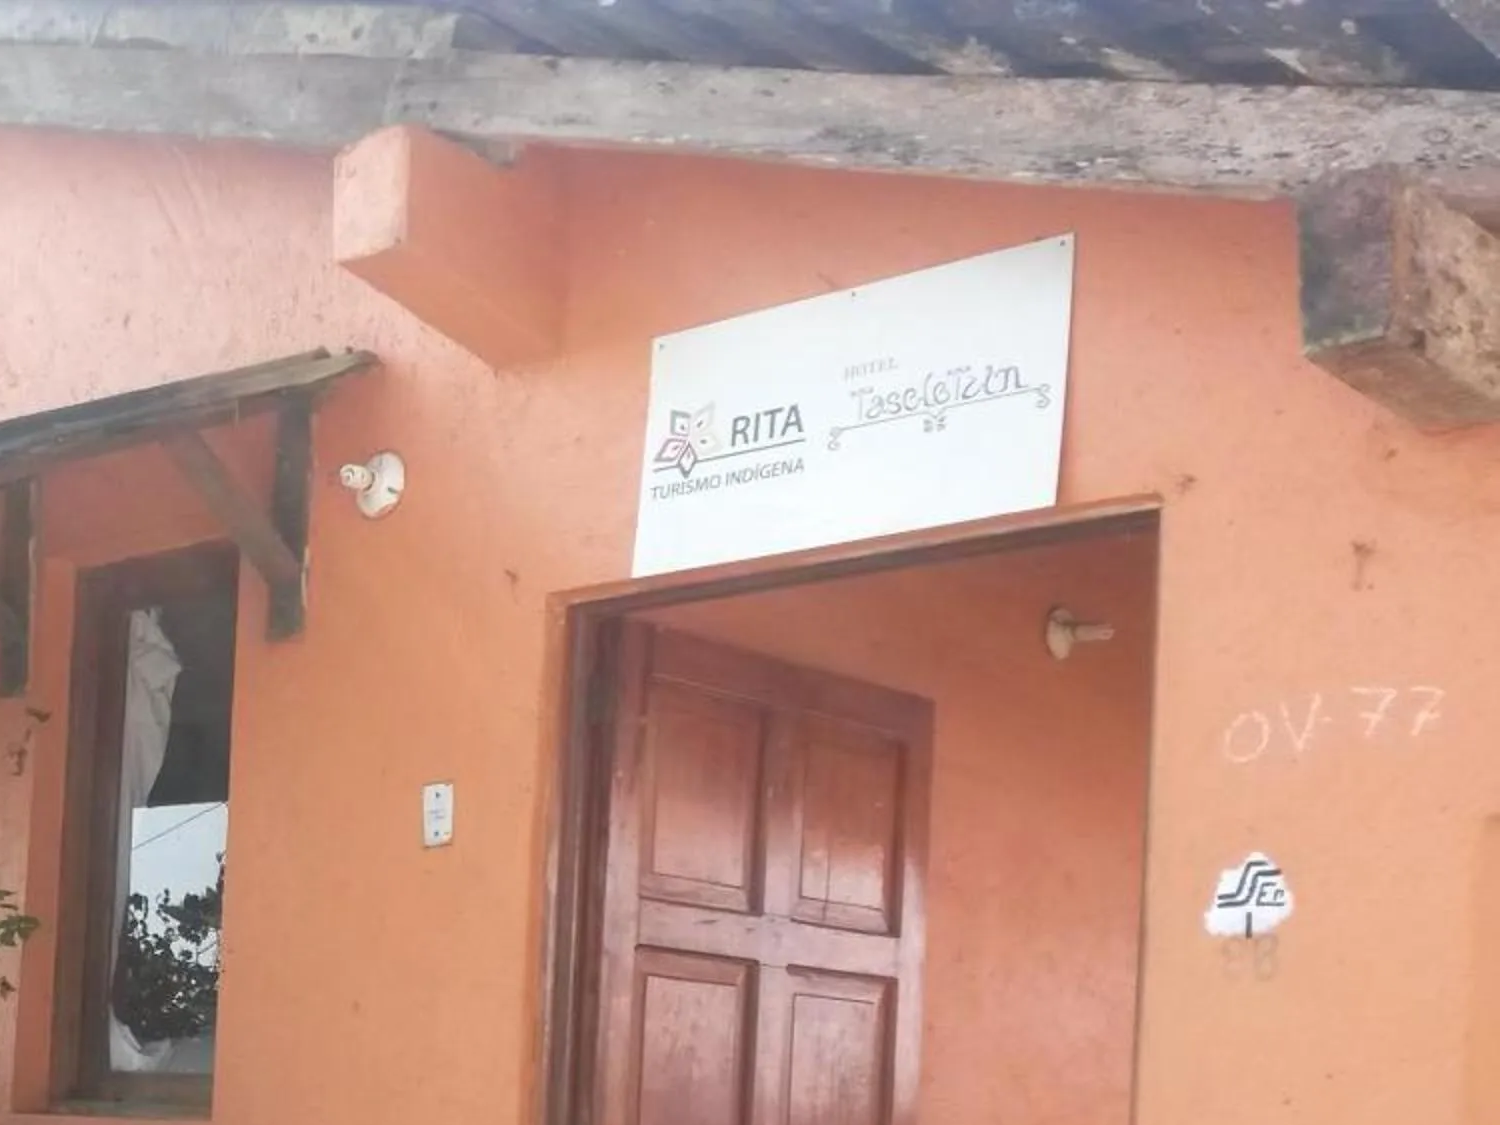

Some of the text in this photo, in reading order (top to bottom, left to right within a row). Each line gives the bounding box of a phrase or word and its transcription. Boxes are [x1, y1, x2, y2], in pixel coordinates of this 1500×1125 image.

[843, 357, 898, 381] HOTEL
[731, 405, 803, 448] RITA
[650, 458, 805, 500] TURISMO INDÍGENA
